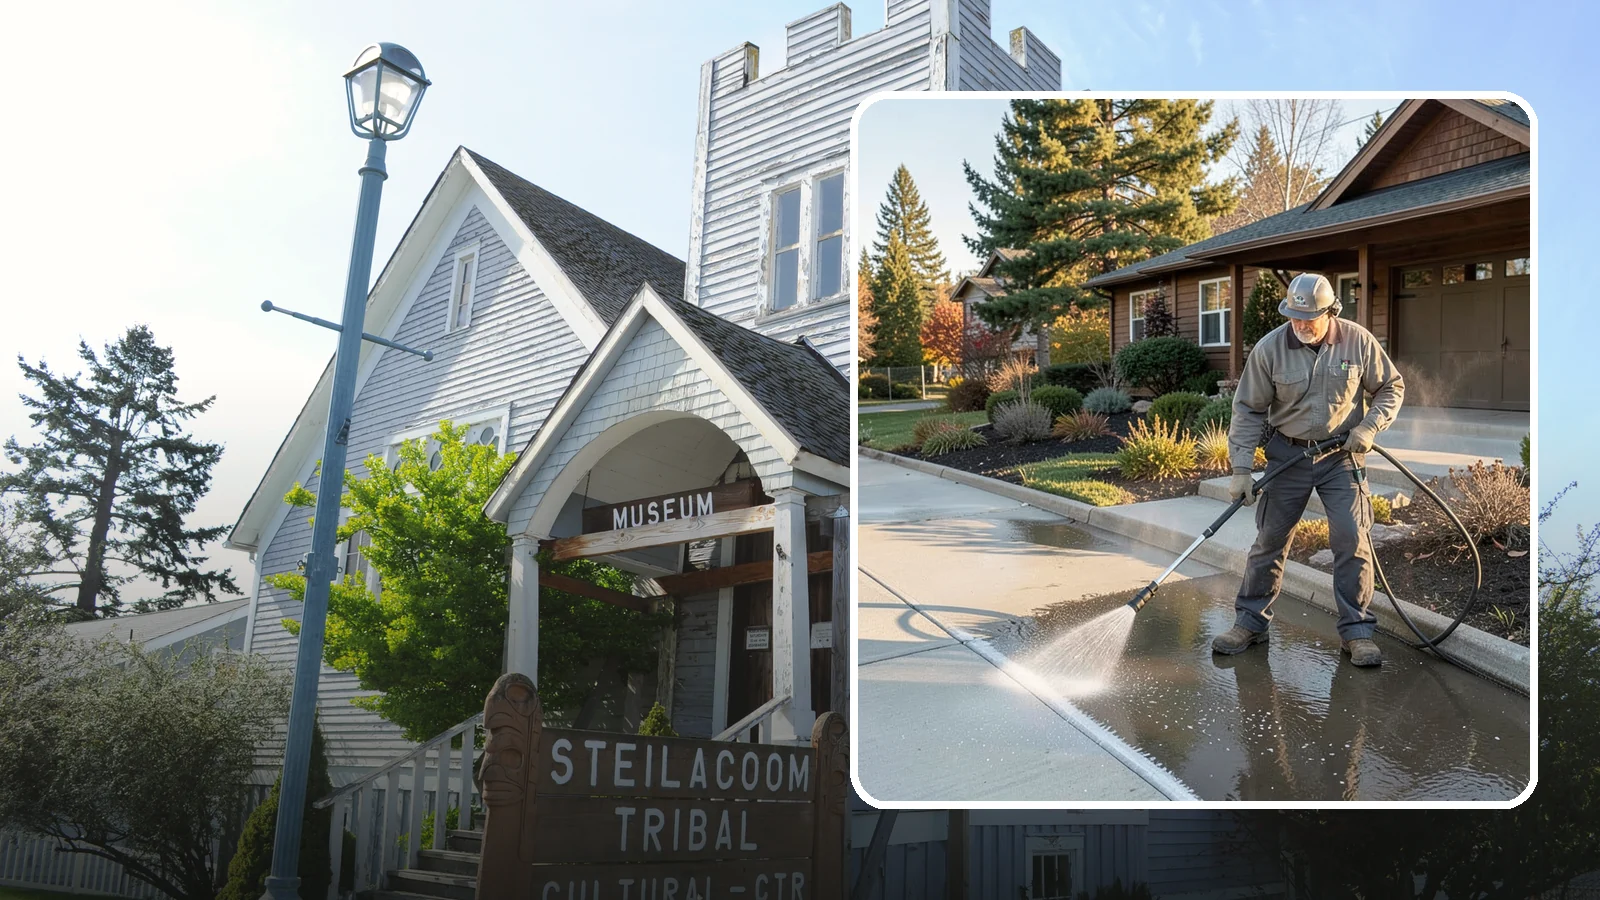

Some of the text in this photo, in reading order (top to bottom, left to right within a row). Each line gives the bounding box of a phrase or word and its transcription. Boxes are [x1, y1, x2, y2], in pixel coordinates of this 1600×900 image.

[613, 491, 714, 531] MUSEUM
[550, 738, 809, 792] STEILACOOM
[615, 806, 758, 852] TRIBAL
